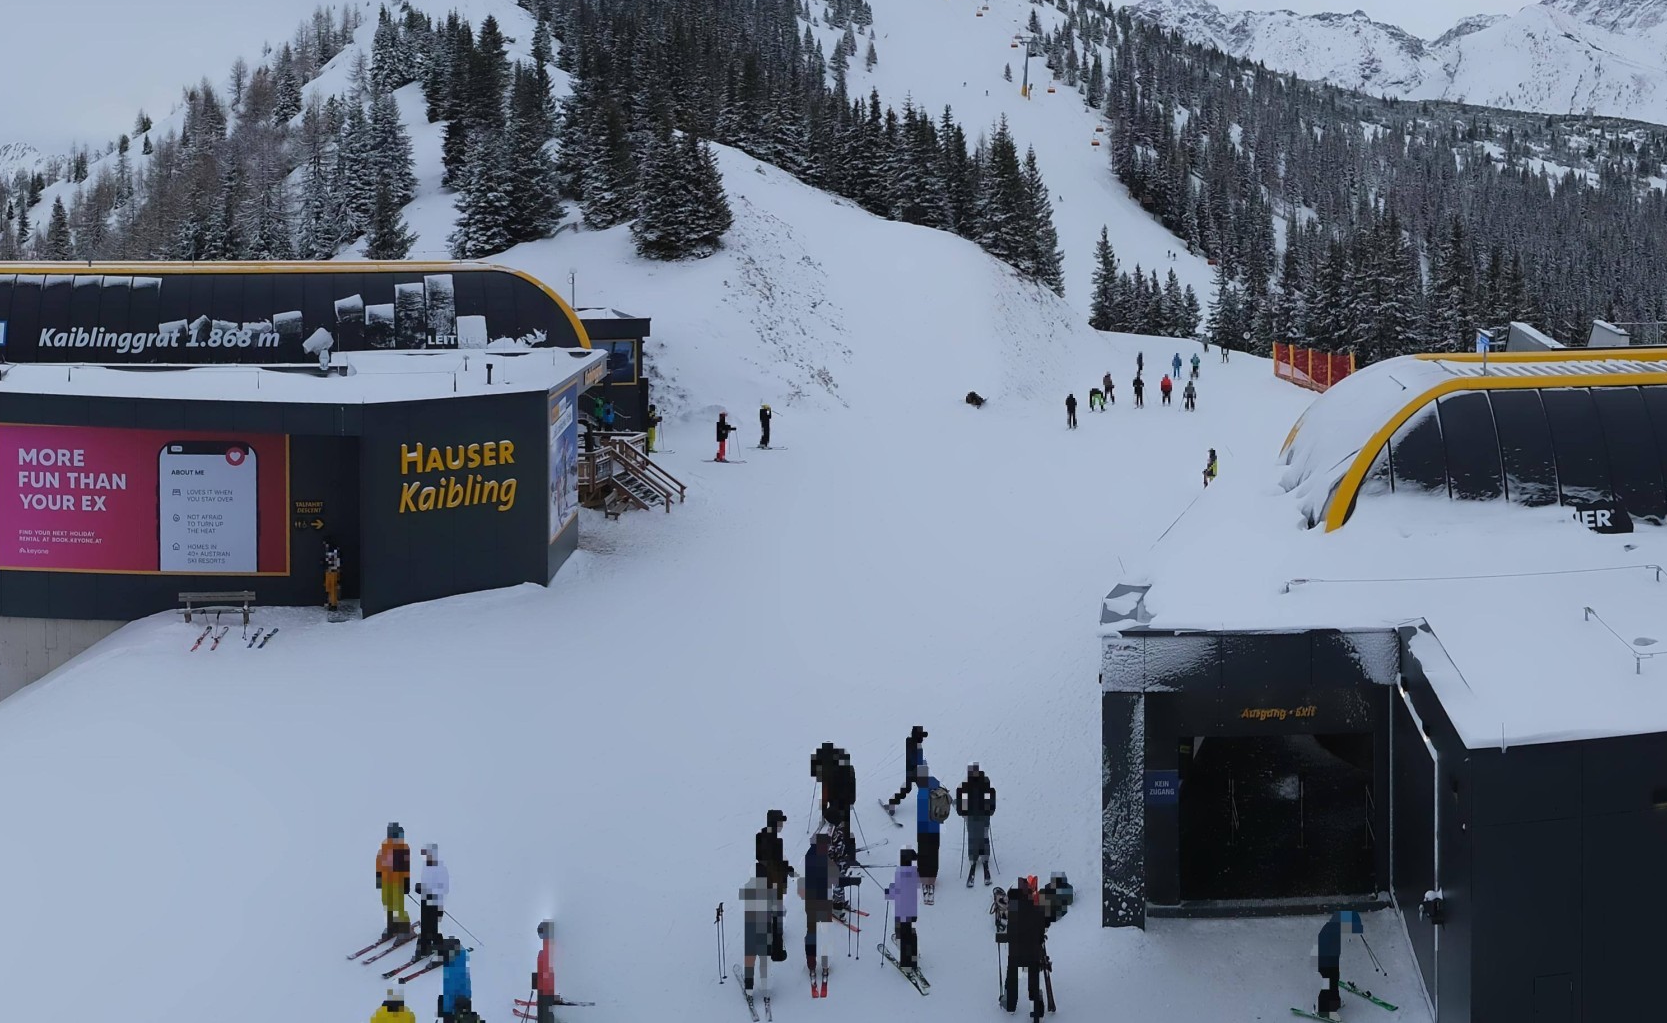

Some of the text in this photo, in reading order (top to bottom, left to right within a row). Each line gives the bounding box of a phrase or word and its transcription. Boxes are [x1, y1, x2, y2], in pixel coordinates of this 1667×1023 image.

[38, 327, 280, 354] Kaiblinggrat 1.868 m
[18, 448, 85, 467] MORE
[400, 440, 515, 475] HAUSER
[18, 471, 127, 490] FUN THAN
[19, 493, 107, 511] YOUR EX
[399, 474, 517, 513] Kaibling
[1241, 705, 1317, 720] Ausgang Exit
